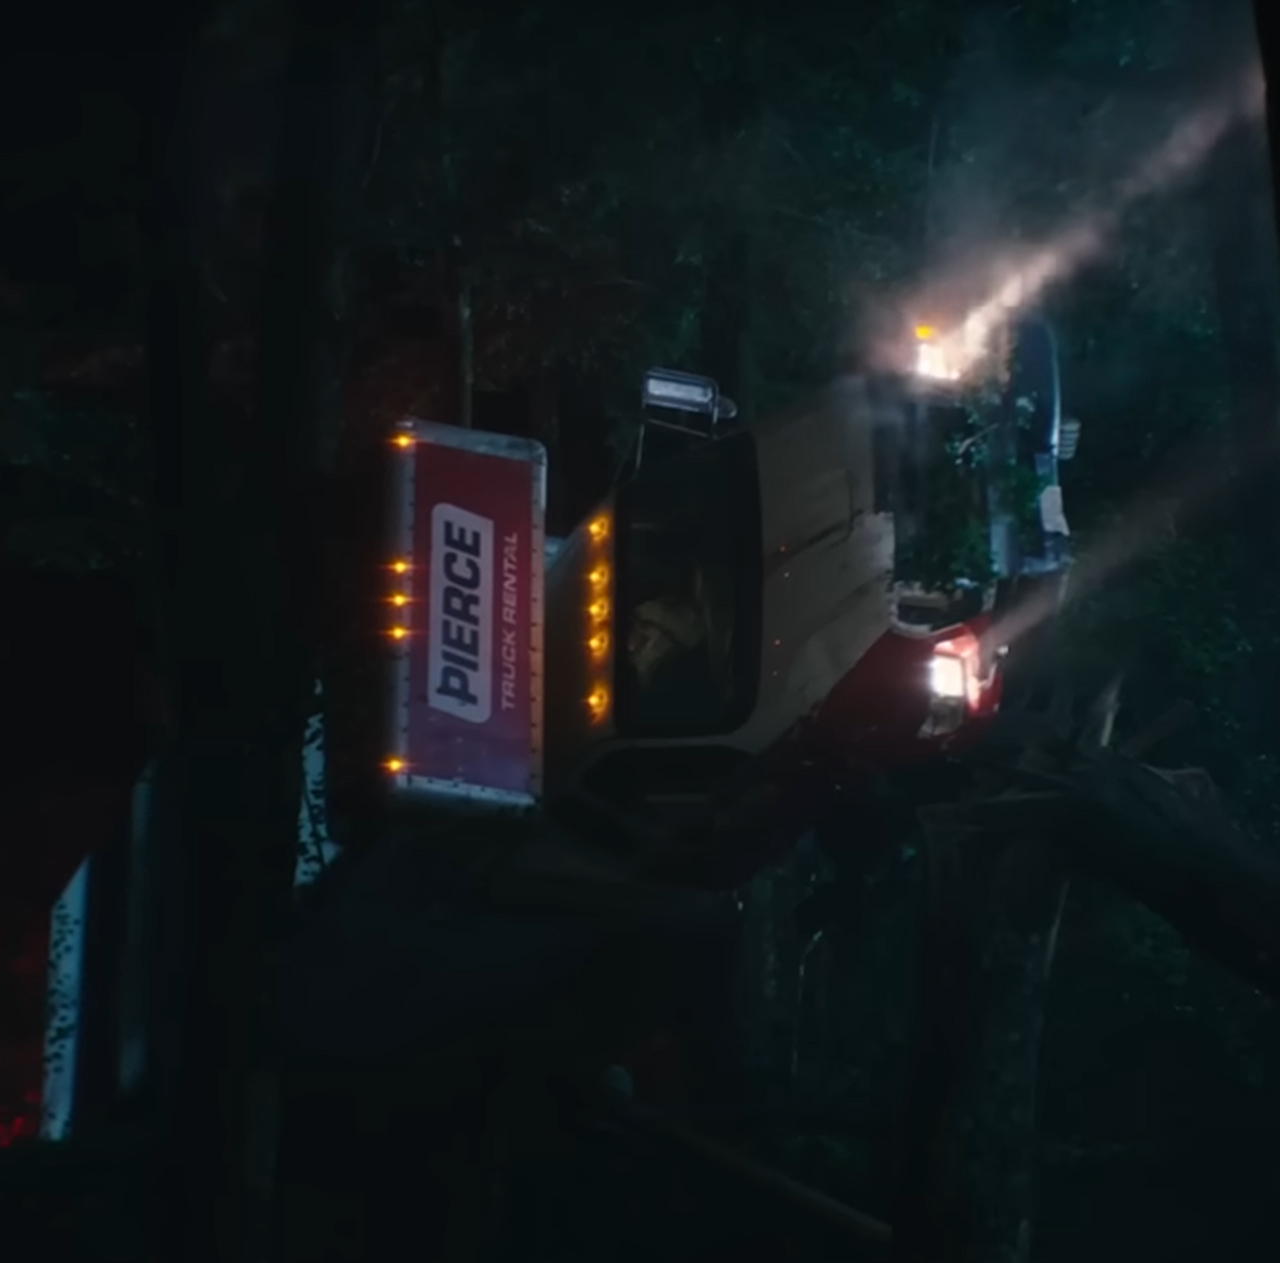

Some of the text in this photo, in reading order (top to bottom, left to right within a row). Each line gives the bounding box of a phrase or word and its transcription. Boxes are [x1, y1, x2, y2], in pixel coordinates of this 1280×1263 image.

[436, 520, 480, 705] PIERCE
[501, 532, 518, 710] TRUCK RENTAL
